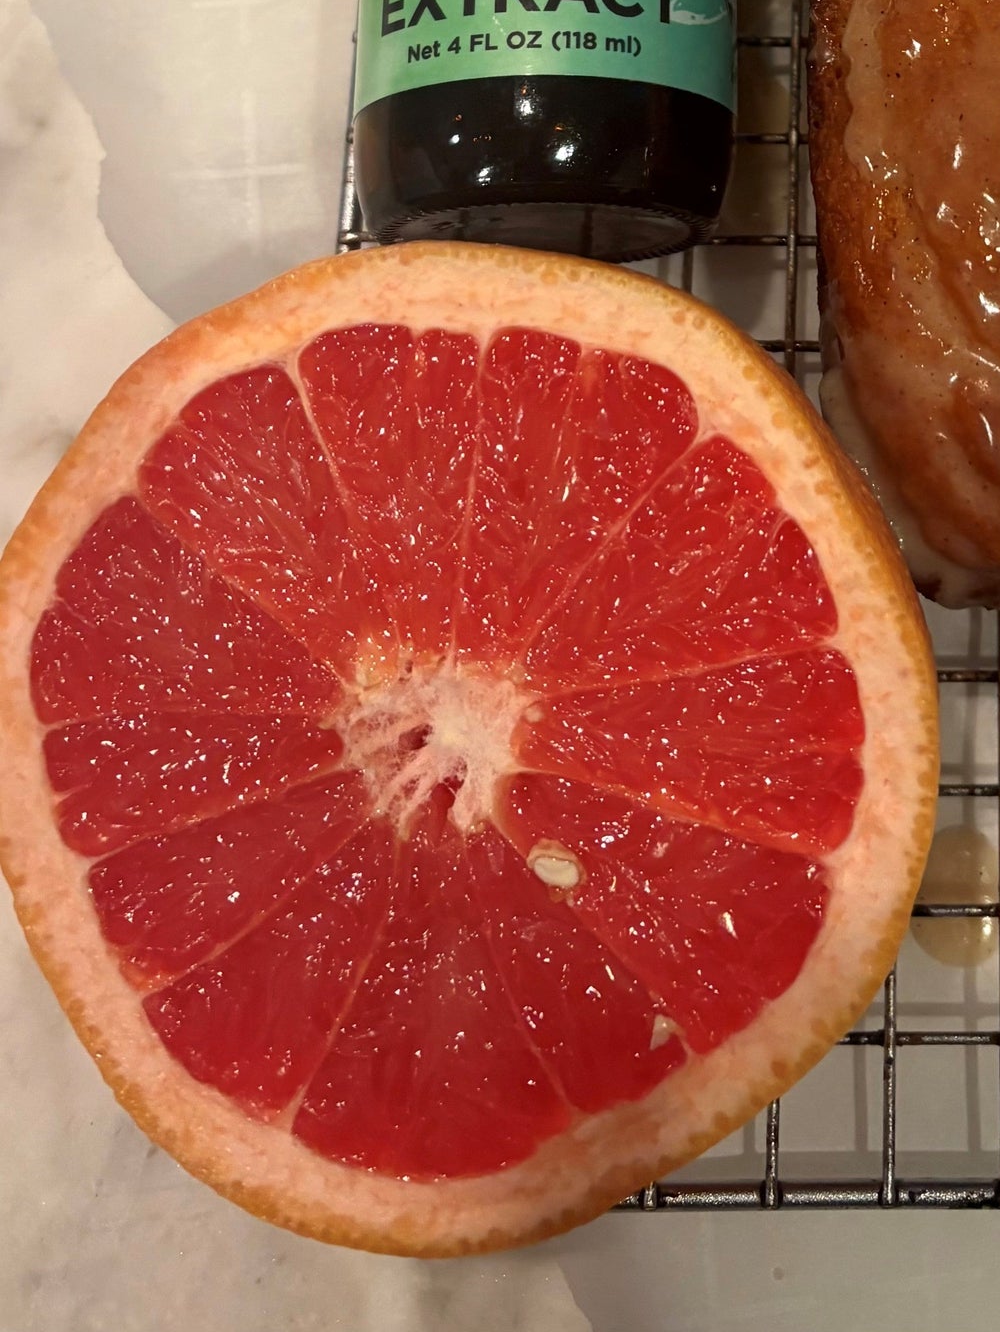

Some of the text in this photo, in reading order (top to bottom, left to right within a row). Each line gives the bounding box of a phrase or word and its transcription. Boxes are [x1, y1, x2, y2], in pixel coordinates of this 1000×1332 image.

[407, 30, 643, 64] Net 4 FL OZ (118 ml)
